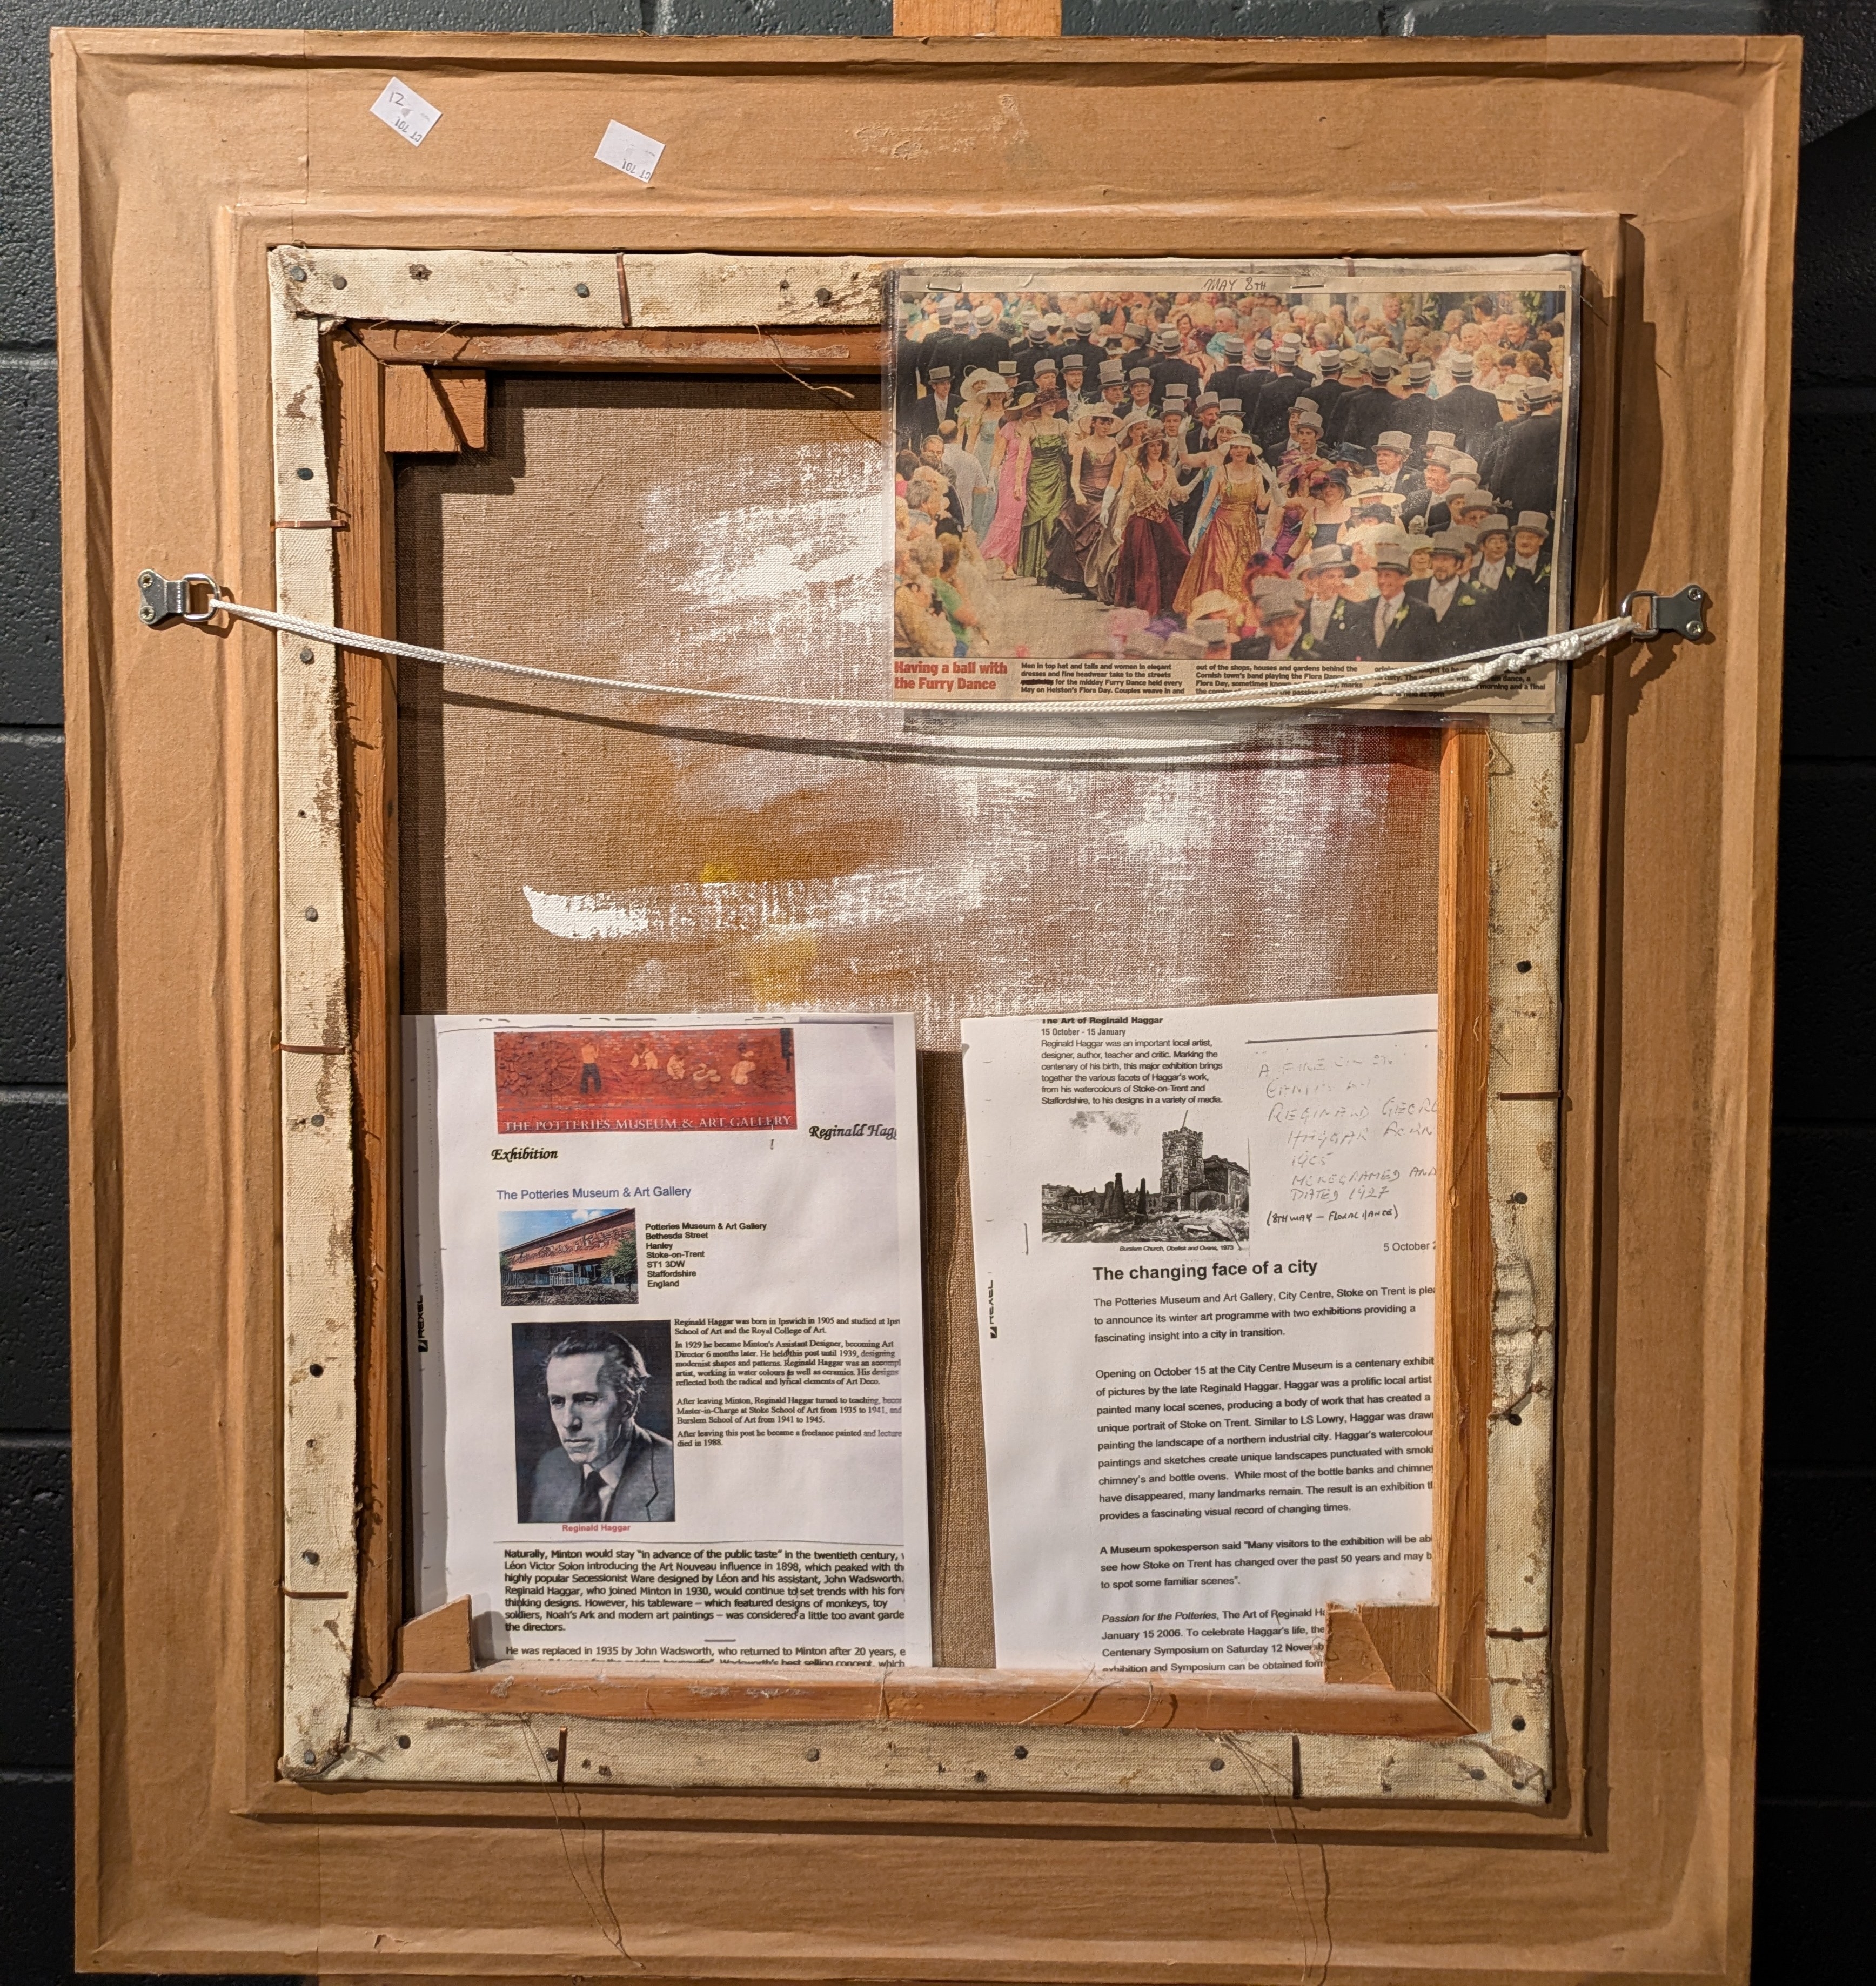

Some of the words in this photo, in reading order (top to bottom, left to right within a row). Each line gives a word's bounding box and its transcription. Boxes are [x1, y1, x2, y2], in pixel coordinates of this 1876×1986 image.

[389, 91, 404, 106] 12
[410, 131, 423, 142] CT
[639, 170, 651, 180] CT
[1201, 278, 1238, 291] MAY
[1245, 277, 1266, 291] 8TH
[894, 660, 938, 676] Having
[941, 664, 949, 673] a
[952, 661, 976, 674] ball
[979, 661, 1007, 674] with
[1230, 664, 1252, 673] shops,
[894, 676, 915, 689] the
[918, 677, 954, 692] Furry
[957, 677, 996, 689] Dance
[1089, 1016, 1128, 1025] Reginald
[1131, 1016, 1163, 1025] Haggar
[1097, 1028, 1125, 1037] January
[1041, 1039, 1073, 1049] Reginald
[1076, 1039, 1103, 1049] Haggar
[1135, 1039, 1170, 1048] important
[1191, 1039, 1212, 1047] artist,
[503, 1121, 531, 1131] THE
[535, 1119, 610, 1131] POTTERIES
[615, 1118, 677, 1129] MUSEUM
[681, 1119, 694, 1128] &
[699, 1117, 726, 1128] ART
[729, 1115, 792, 1127] GALLERY
[809, 1123, 867, 1140] Reginald
[491, 1146, 558, 1162] Exhibition
[496, 1190, 517, 1199] The
[521, 1189, 569, 1199] Potteries
[572, 1187, 619, 1198] Museum
[622, 1187, 631, 1197] &
[633, 1186, 650, 1197] Art
[653, 1186, 691, 1198] Gallery
[1349, 1185, 1389, 1200] 1927
[739, 1222, 767, 1231] Gallery
[645, 1232, 682, 1240] Bethesda
[646, 1242, 673, 1250] Hanley
[1383, 1243, 1389, 1251] 5
[1392, 1242, 1430, 1251] October
[646, 1250, 705, 1258] Stoke-on-Trent
[1092, 1266, 1124, 1280] The
[1129, 1264, 1207, 1281] changing
[1211, 1262, 1247, 1276] face
[1252, 1260, 1269, 1274] of
[1273, 1264, 1282, 1273] a
[1288, 1259, 1317, 1276] city
[647, 1279, 679, 1289] England
[1093, 1298, 1111, 1306] The
[1115, 1297, 1156, 1306] Potteries
[1160, 1296, 1200, 1304] Museum
[1203, 1293, 1220, 1303] and
[1223, 1293, 1237, 1301] Art
[1240, 1292, 1275, 1302] Gallery,
[1278, 1291, 1297, 1301] City
[1299, 1290, 1334, 1299] Centre,
[1336, 1288, 1363, 1297] Stoke
[1380, 1287, 1405, 1295] Trent
[1408, 1286, 1416, 1294] is
[417, 1294, 425, 1338] REXEL
[562, 1524, 598, 1533] Reginald
[600, 1524, 631, 1532] Haggar
[504, 1560, 526, 1569] Léon
[529, 1561, 555, 1570] Victor
[558, 1561, 584, 1570] Solon
[587, 1561, 638, 1572] introducing
[641, 1562, 656, 1571] the
[659, 1562, 673, 1571] Art
[676, 1562, 716, 1571] Nouveau
[720, 1561, 761, 1571] influence
[764, 1561, 773, 1569] in
[776, 1562, 801, 1572] 1898,
[805, 1562, 832, 1571] which
[834, 1562, 868, 1573] peaked
[870, 1562, 890, 1571] with
[894, 1562, 904, 1571] th
[1113, 1580, 1133, 1590] spot
[1163, 1576, 1198, 1586] familiar
[1201, 1575, 1240, 1585] scenes".
